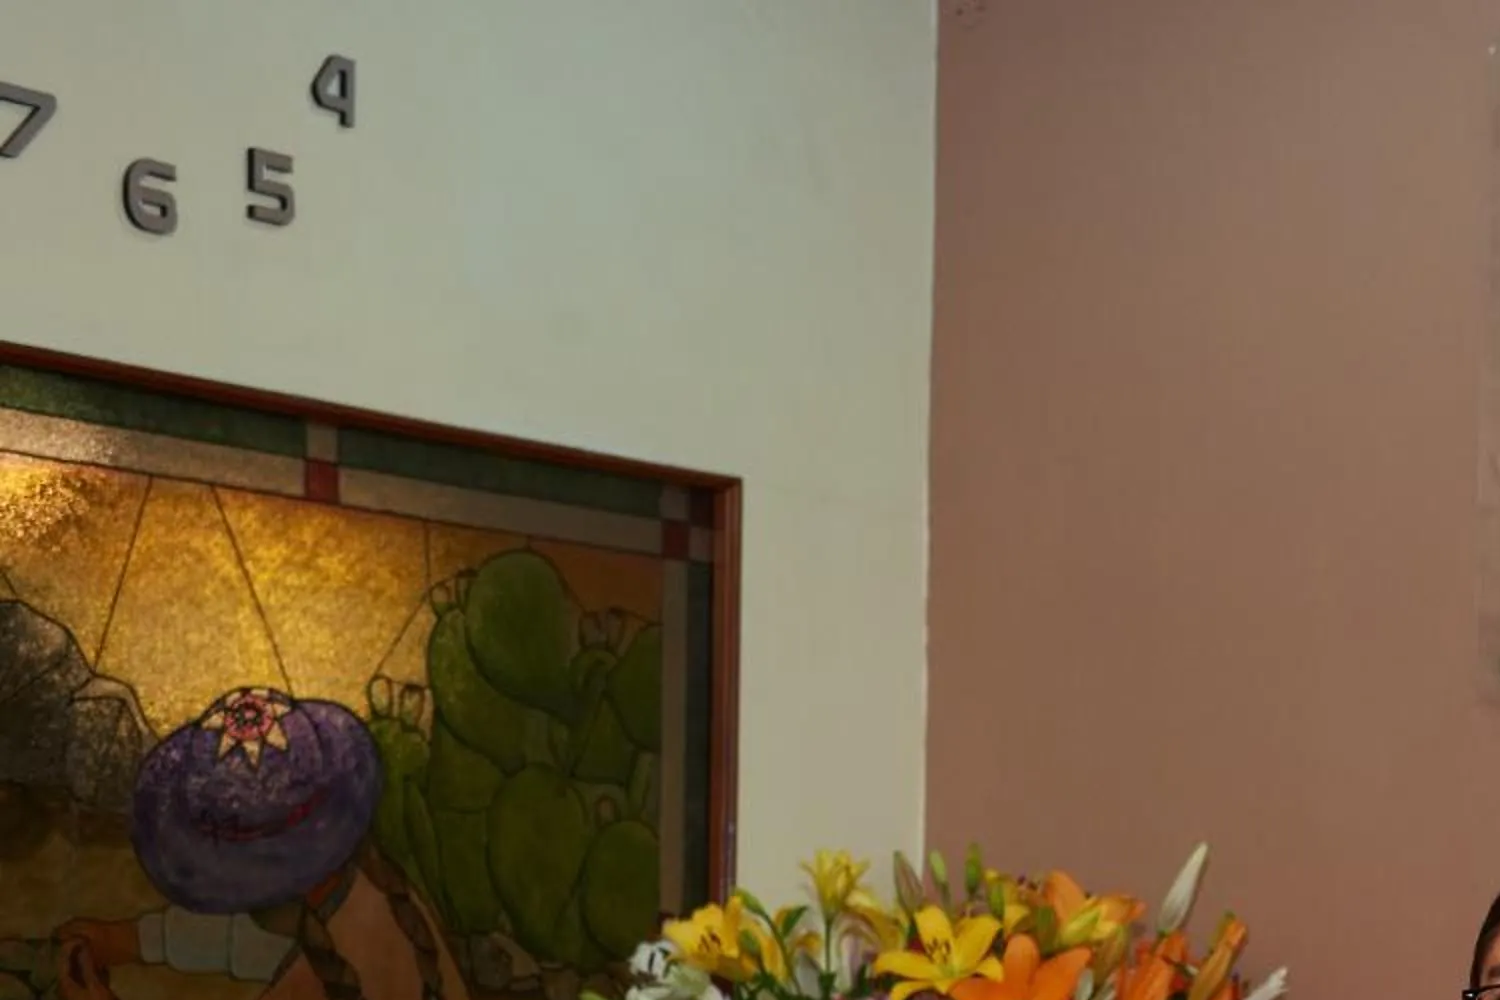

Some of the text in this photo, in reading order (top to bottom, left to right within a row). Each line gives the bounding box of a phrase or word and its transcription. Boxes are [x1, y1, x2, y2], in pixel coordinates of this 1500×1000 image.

[0, 81, 57, 158] 7
[310, 55, 356, 129] 4
[122, 158, 177, 236] 6
[246, 147, 295, 227] 5
